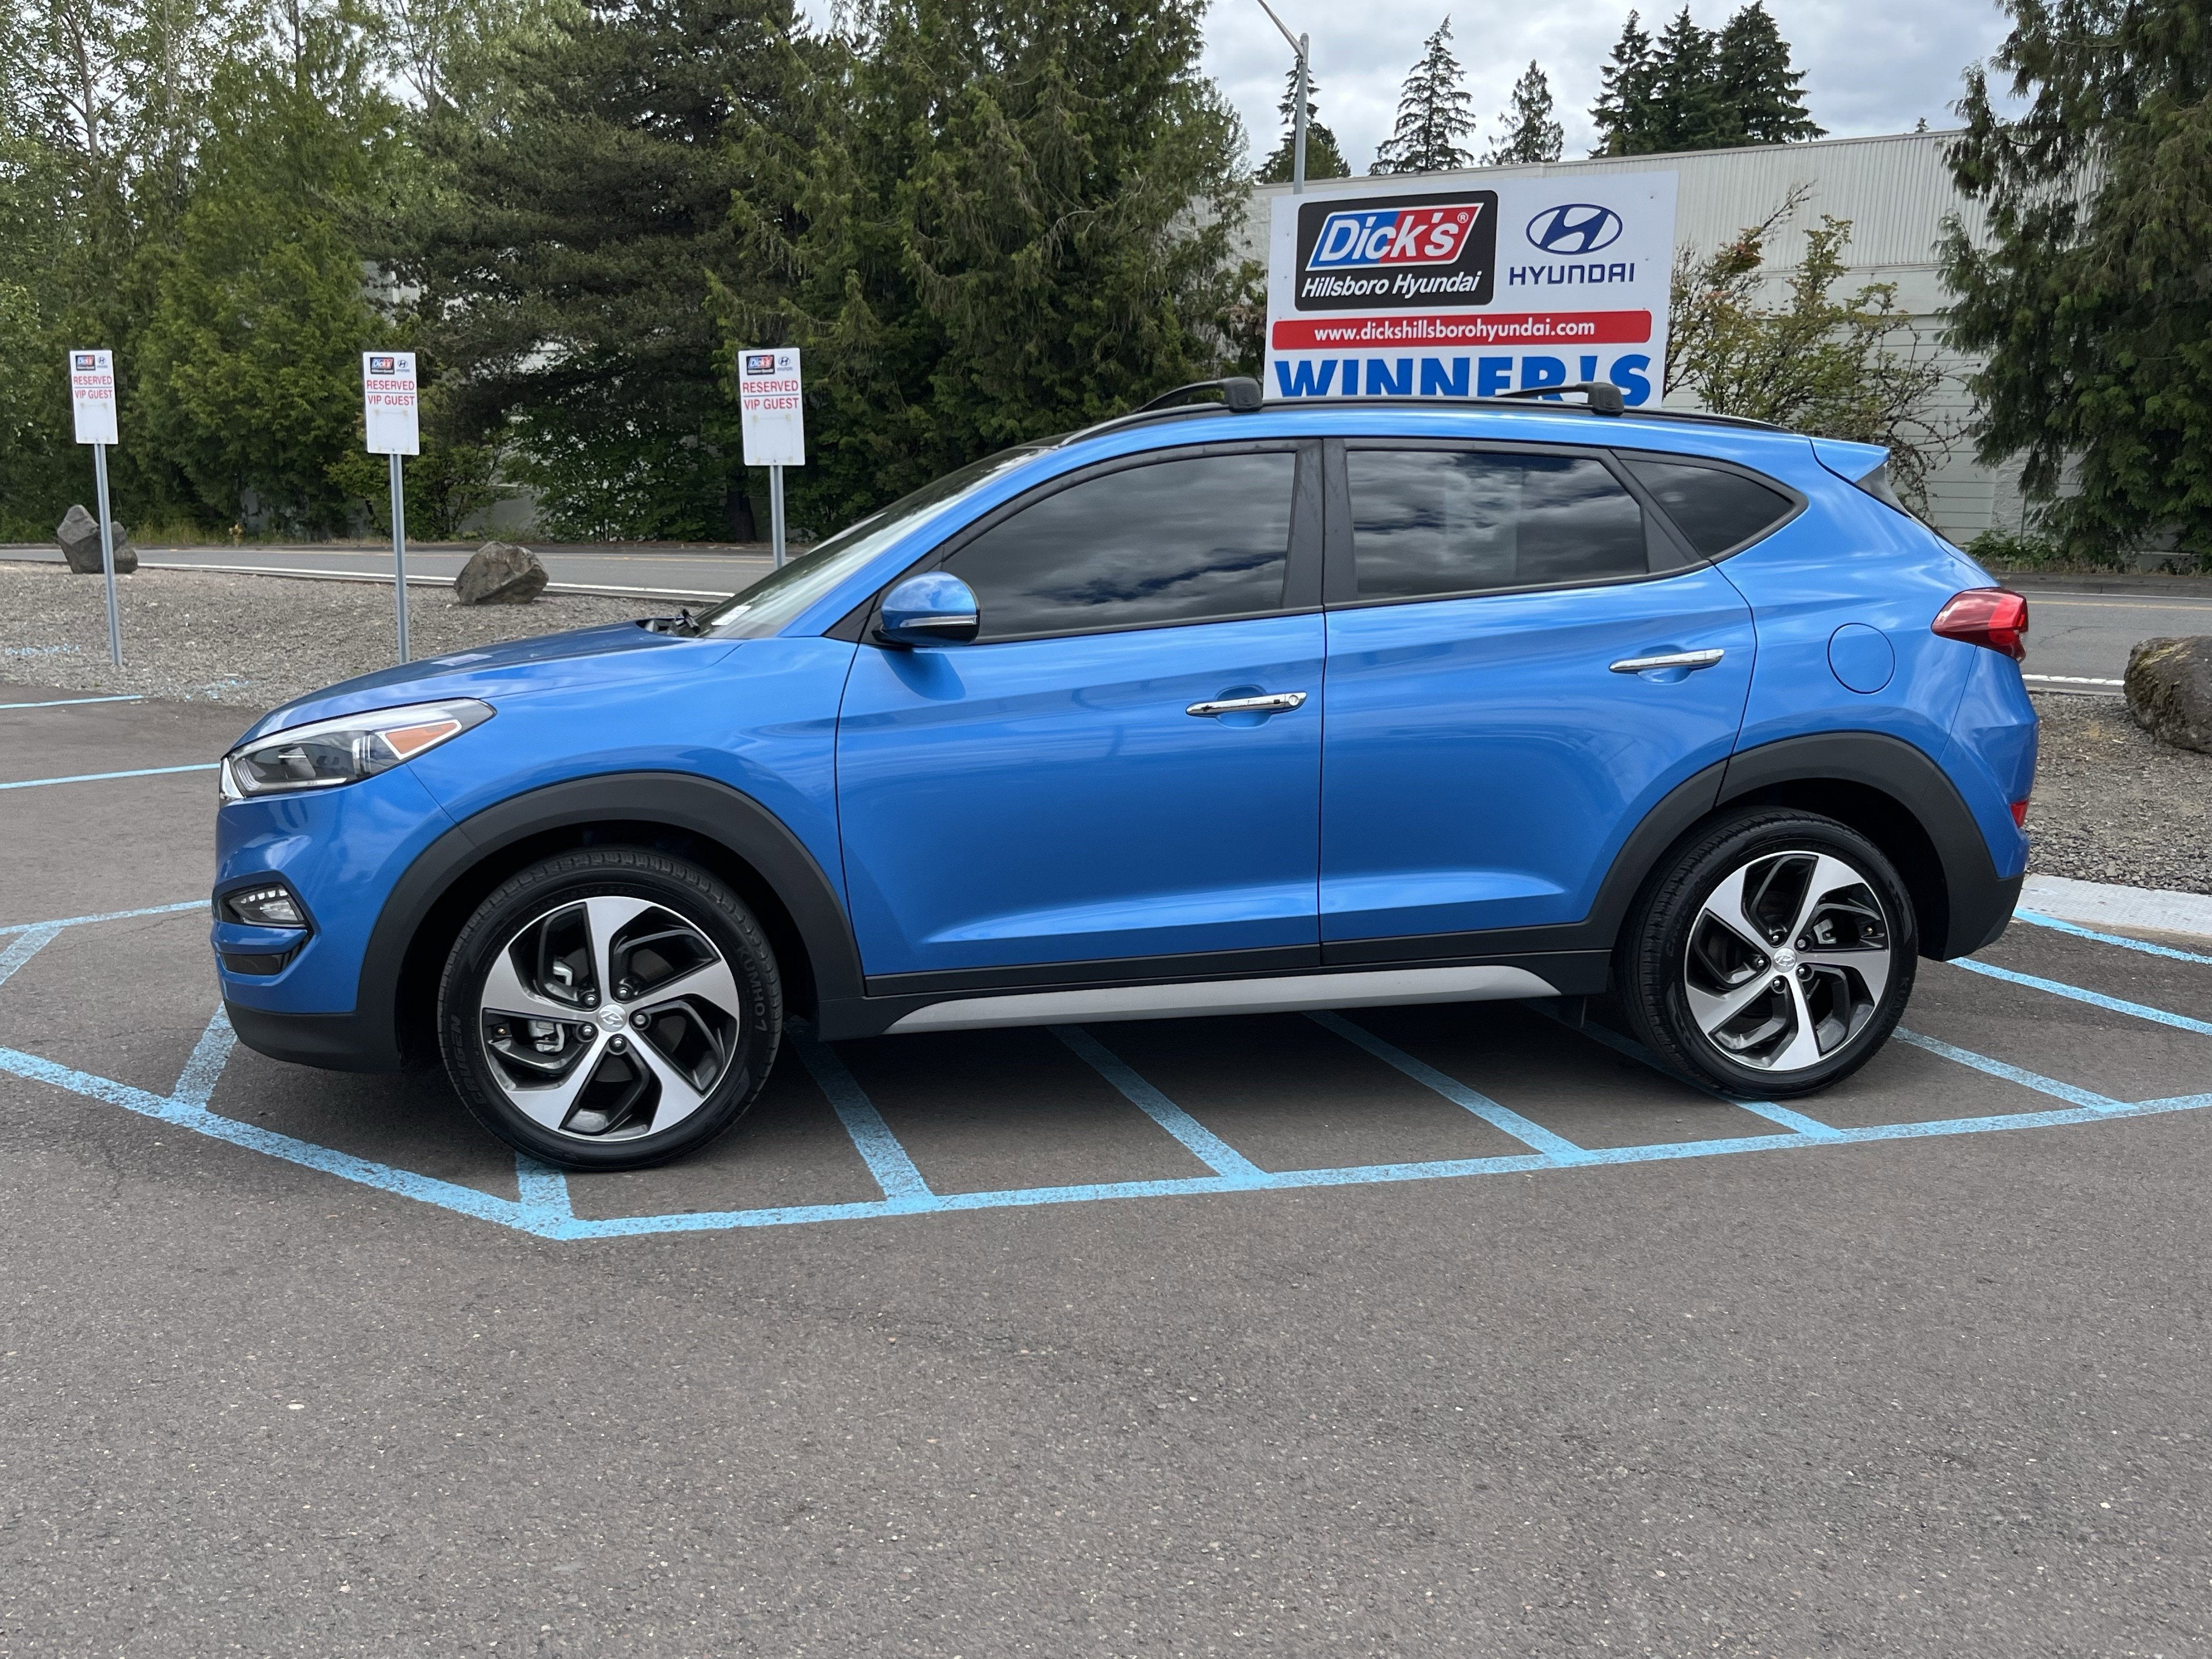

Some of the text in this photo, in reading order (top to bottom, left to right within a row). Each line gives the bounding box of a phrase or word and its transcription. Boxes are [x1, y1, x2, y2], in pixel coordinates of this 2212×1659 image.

[1319, 212, 1459, 262] Dick's
[1509, 263, 1635, 286] HYUNDAI
[1301, 271, 1482, 299] Hillsboro Hyundai
[1314, 317, 1595, 342] www.dickshillsborohyundai.com
[74, 376, 112, 385] RESERVED
[366, 380, 415, 391] RESERVED
[1274, 354, 1651, 407] WINNER'S
[743, 381, 798, 393] RESERVED
[75, 390, 112, 399] VIP GUEST
[368, 395, 415, 406] VIP GUEST
[744, 398, 799, 410] VIP GUEST
